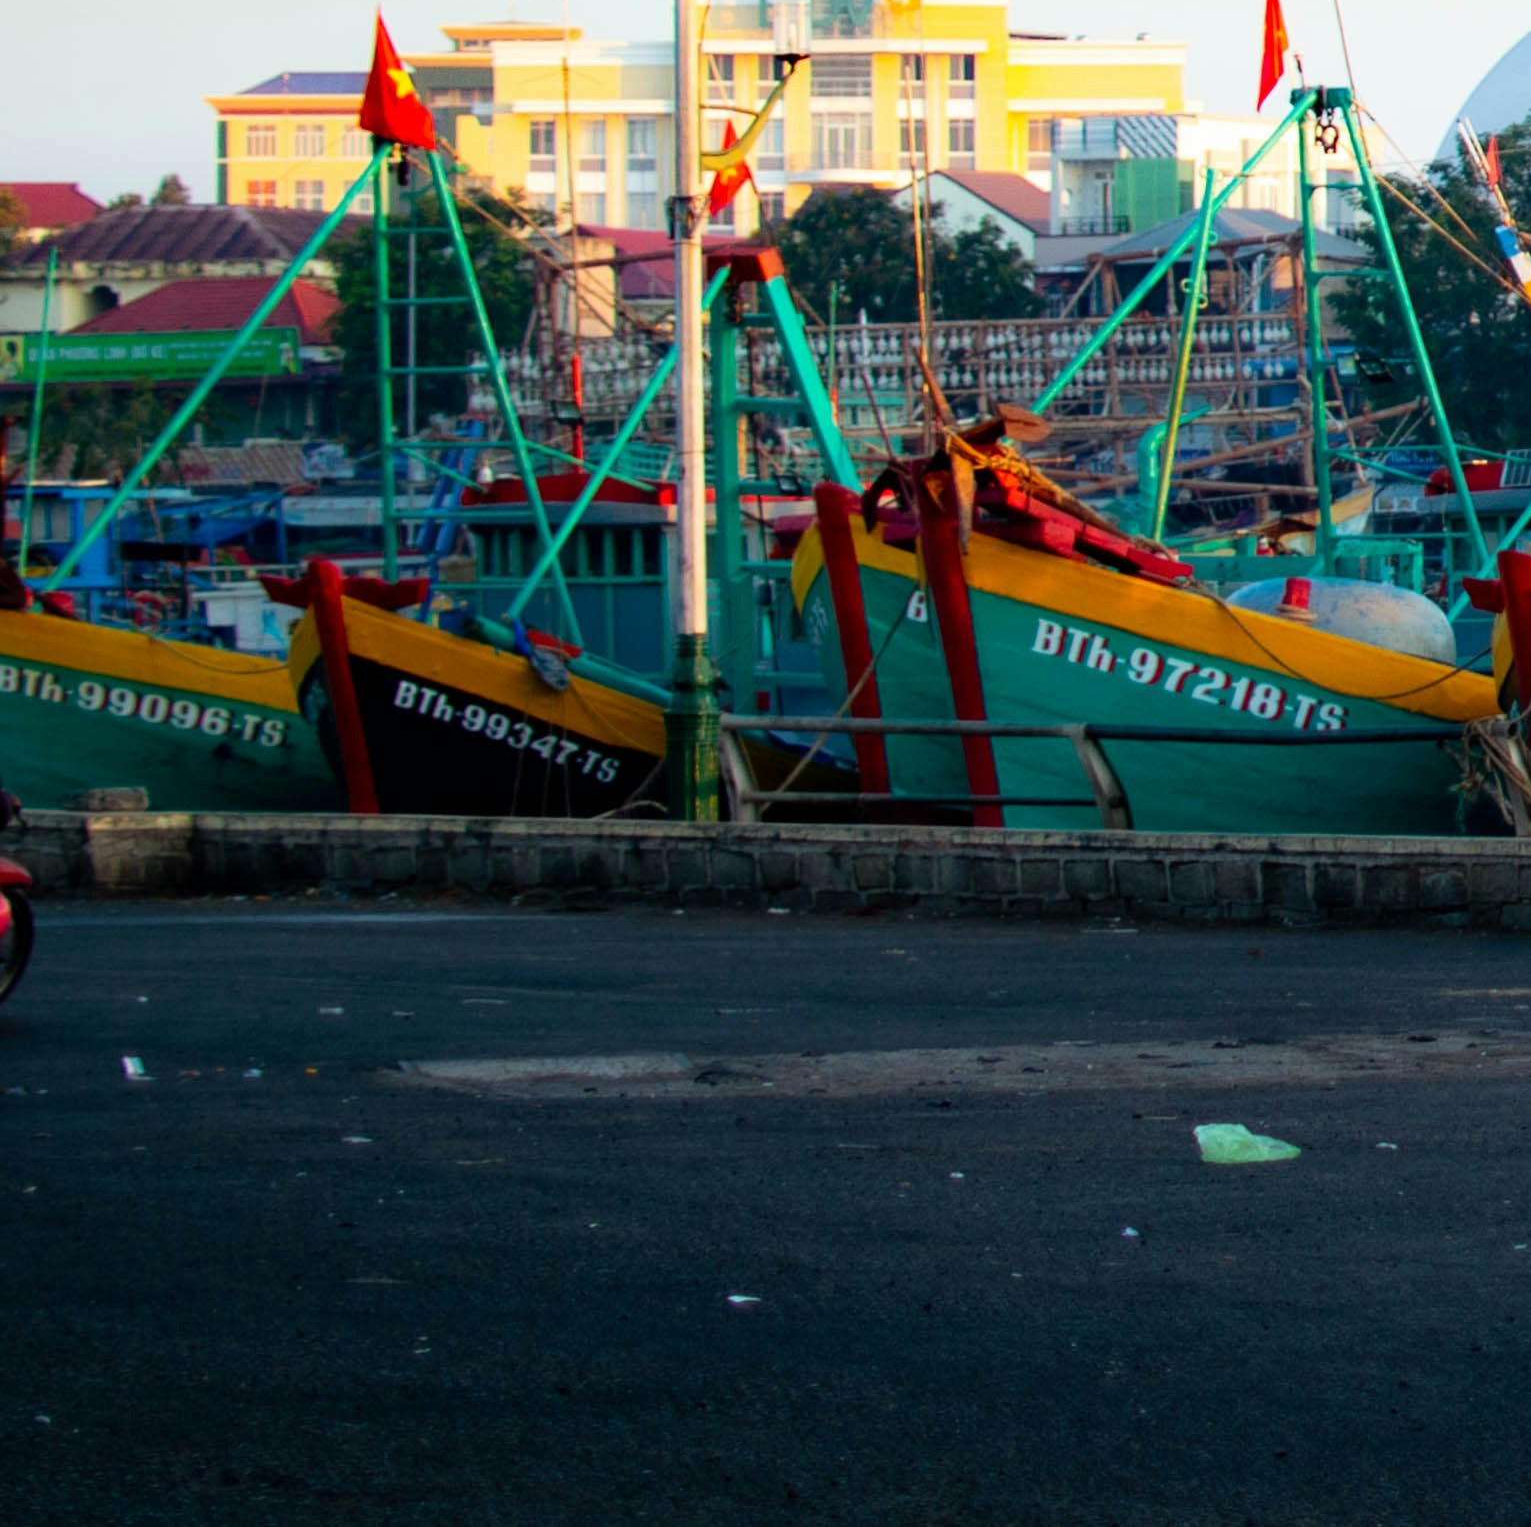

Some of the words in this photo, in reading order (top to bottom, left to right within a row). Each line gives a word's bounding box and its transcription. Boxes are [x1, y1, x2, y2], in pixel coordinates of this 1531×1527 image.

[0, 664, 287, 747] BTh-99096-TS
[1031, 617, 1350, 732] BTh-97218-TS
[393, 679, 621, 783] BTh-99347-TS
